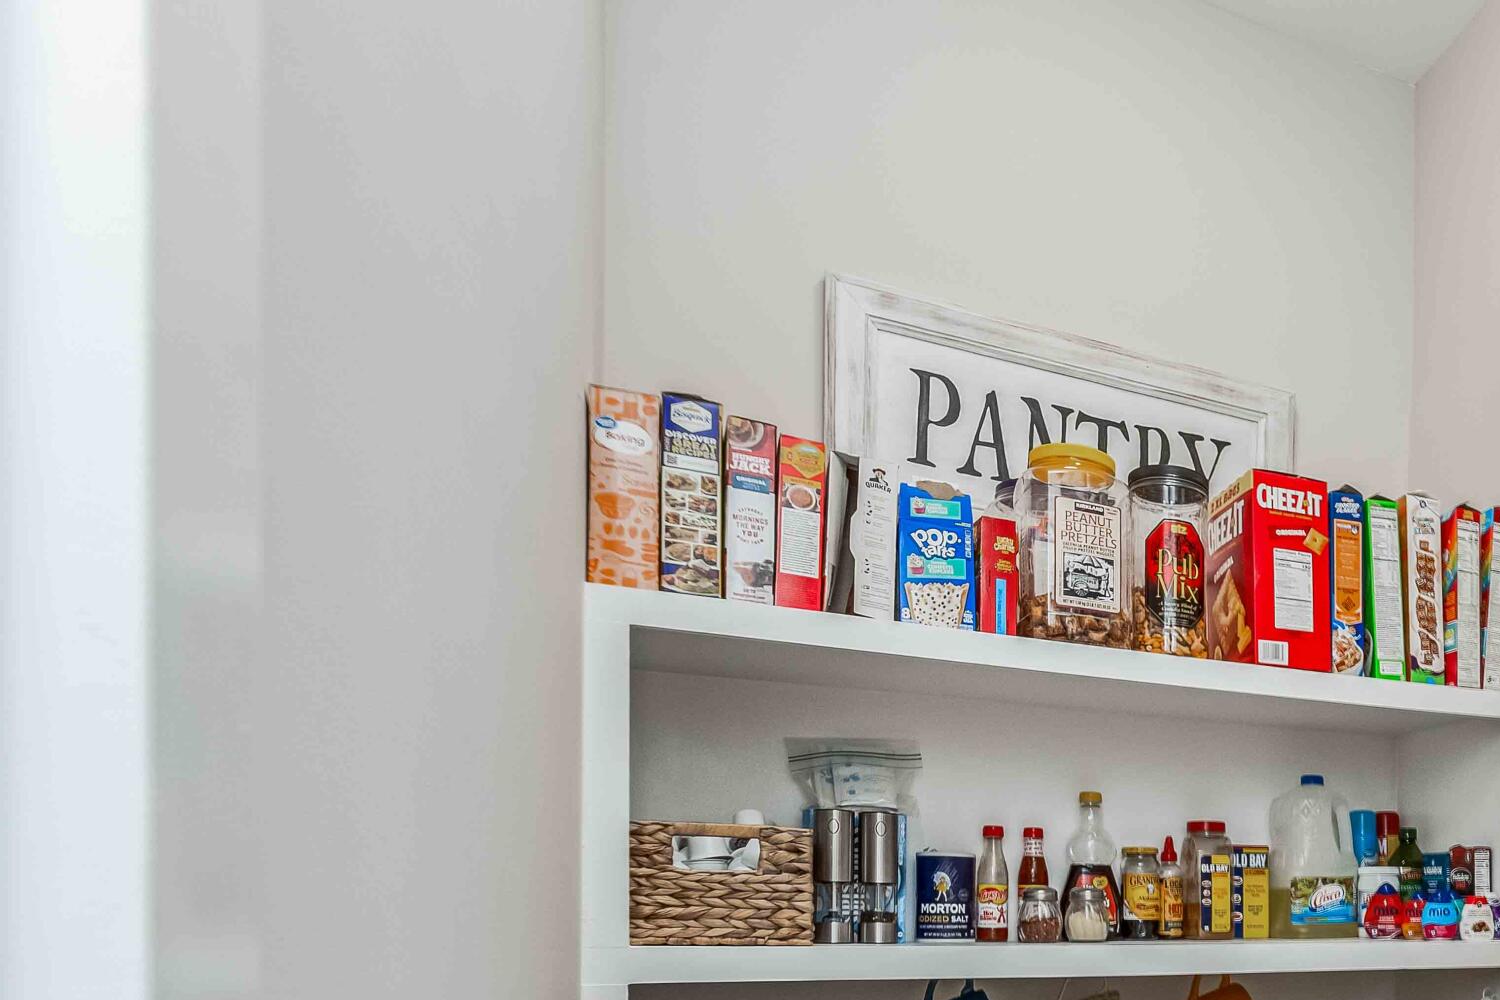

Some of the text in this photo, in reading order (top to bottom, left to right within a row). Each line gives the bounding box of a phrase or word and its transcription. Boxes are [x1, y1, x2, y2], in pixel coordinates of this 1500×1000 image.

[730, 461, 772, 476] JACK
[865, 481, 892, 494] QUAKER
[1075, 503, 1104, 513] KIRKLAND
[732, 514, 768, 525] MORNINGS
[1065, 511, 1113, 528] PEANUT
[741, 530, 758, 538] YOU
[1065, 521, 1113, 539] BUTTER
[1060, 530, 1117, 550] PRETZELS
[920, 544, 955, 559] tarts
[1157, 548, 1199, 579] Pub
[1157, 573, 1199, 605] Mix
[1249, 853, 1266, 868] BAY
[1201, 863, 1229, 873] OLD BAY
[921, 902, 966, 914] MORTON
[1374, 906, 1399, 916] mio
[1429, 906, 1450, 917] mio
[951, 914, 968, 923] SALT
